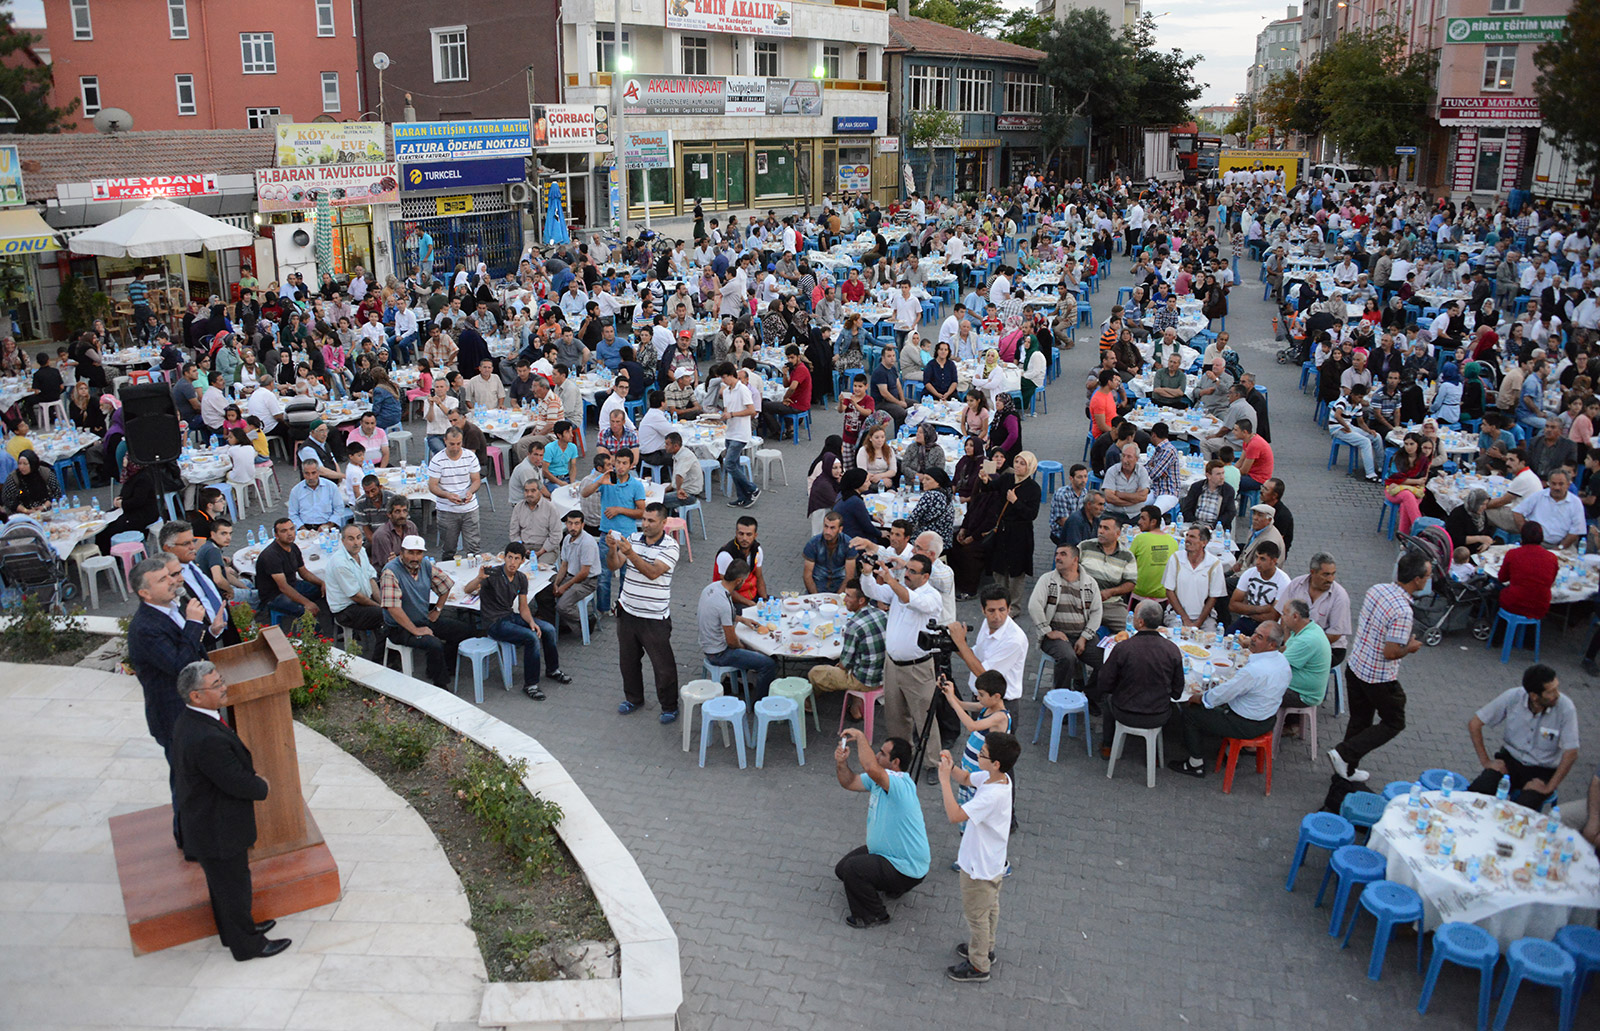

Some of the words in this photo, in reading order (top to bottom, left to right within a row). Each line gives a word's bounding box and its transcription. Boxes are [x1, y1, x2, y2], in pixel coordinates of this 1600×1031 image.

[731, 0, 775, 20] AKALIN
[1471, 20, 1501, 31] RİBAT
[1503, 19, 1538, 31] EĞİTİM
[1540, 18, 1570, 30] VAKF
[647, 79, 686, 93] AKALIN
[688, 76, 723, 97] İNŞAAT
[1444, 98, 1486, 107] TUNCAY
[1487, 98, 1539, 107] MATBAAC
[548, 113, 594, 126] ÇORBACI
[395, 127, 427, 137] KARAN
[429, 124, 466, 136] İLETİŞİM
[468, 123, 500, 134] FATURA
[502, 121, 528, 133] MATİK
[549, 125, 595, 138] HİKMET
[340, 140, 366, 151] EVE
[400, 142, 444, 154] FATURA
[447, 139, 483, 151] ÖDEME
[485, 138, 529, 149] NOKTASI
[631, 136, 663, 147] ÇORBACI
[108, 174, 203, 188] MEYDAN
[258, 168, 315, 183] H.BARAN
[424, 169, 462, 181] TURKCELL
[119, 184, 191, 196] KAHVESİ
[0, 238, 48, 254] ONU
